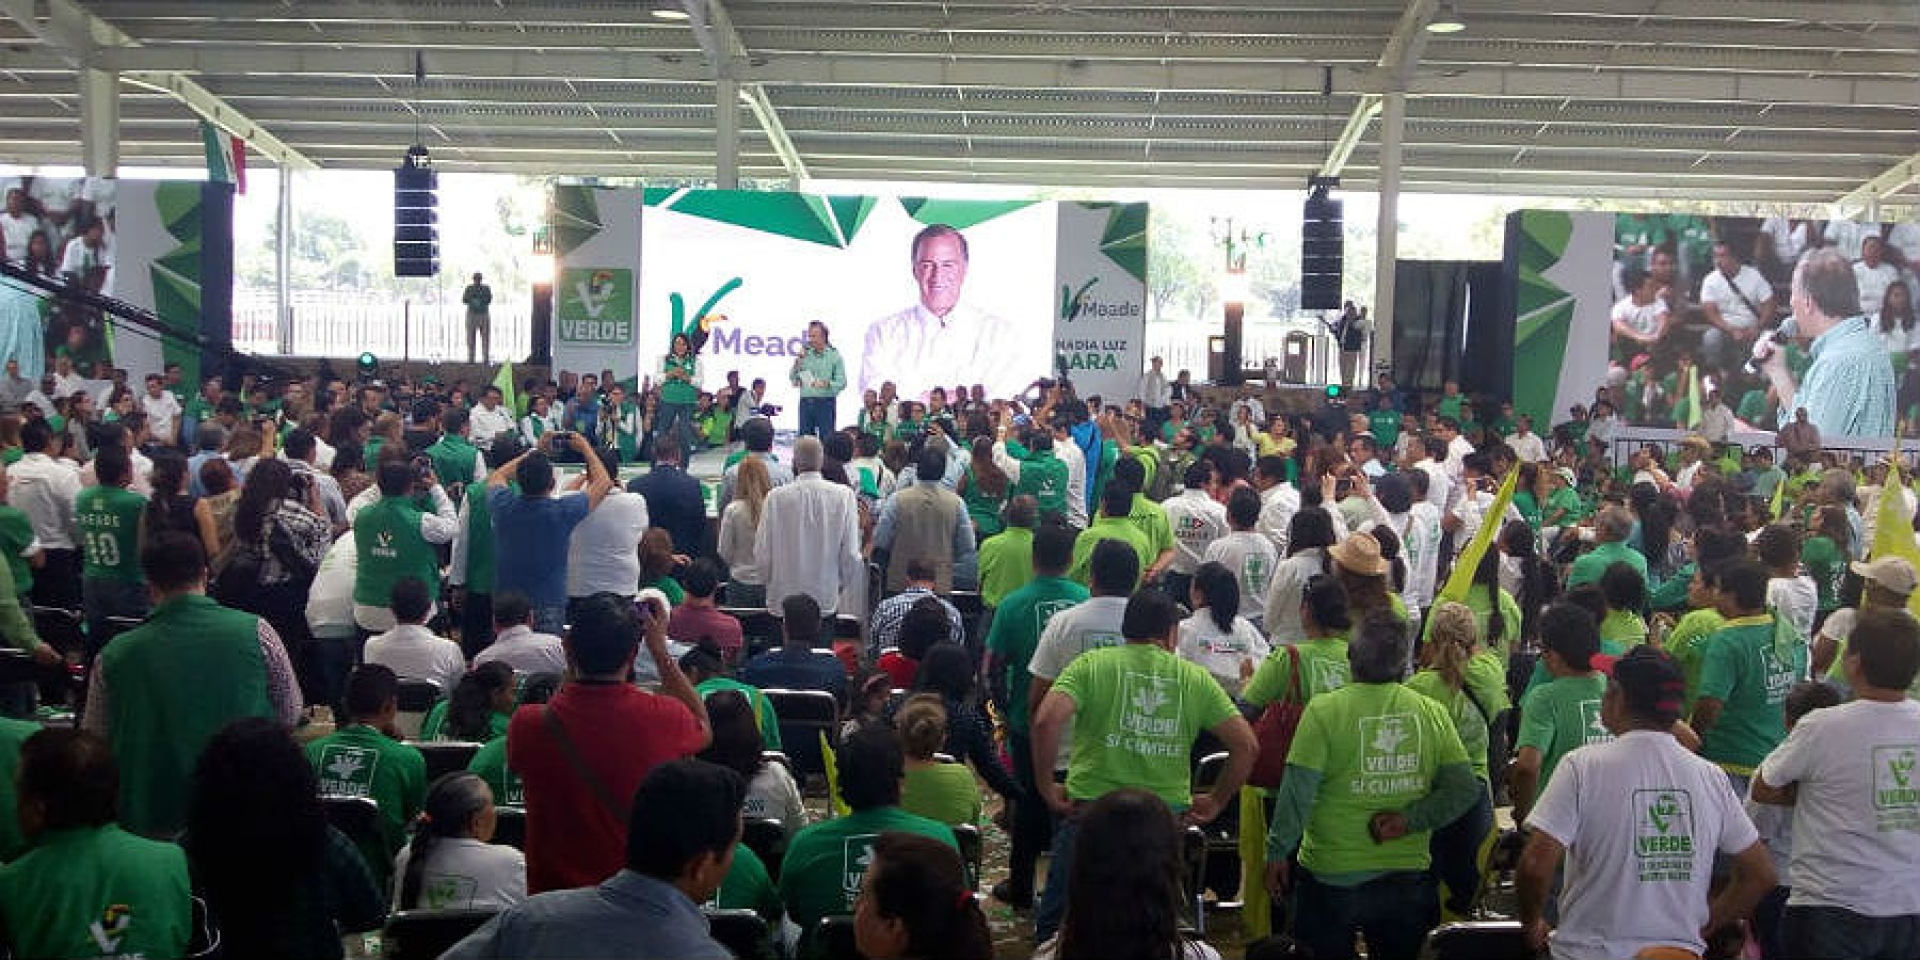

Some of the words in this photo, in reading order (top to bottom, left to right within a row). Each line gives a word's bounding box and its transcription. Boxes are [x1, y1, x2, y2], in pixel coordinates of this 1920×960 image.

[1083, 301, 1139, 317] Meade
[562, 321, 628, 340] VERDE
[714, 327, 808, 356] Mead
[1056, 341, 1098, 351] NADIA
[1103, 341, 1127, 351] LUZ
[1639, 836, 1691, 852] VERDE
